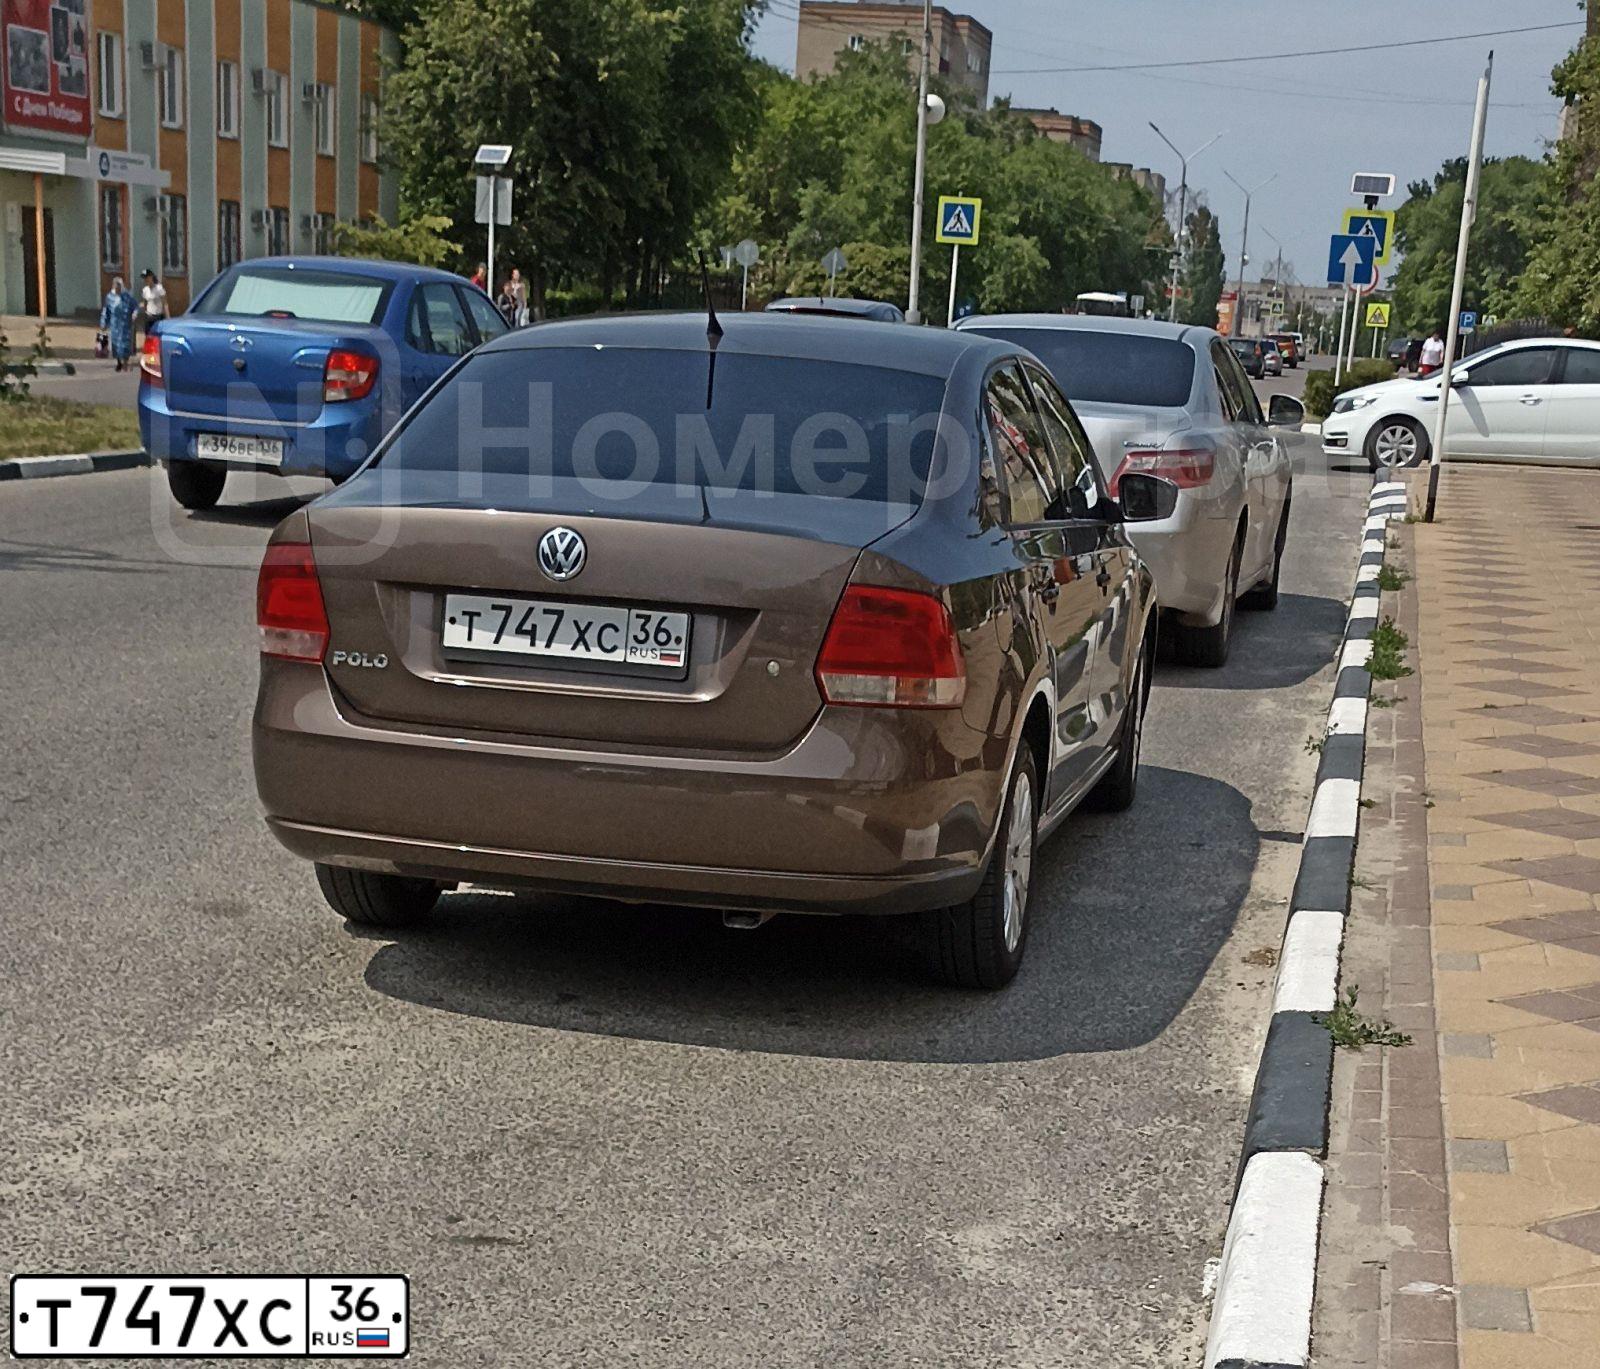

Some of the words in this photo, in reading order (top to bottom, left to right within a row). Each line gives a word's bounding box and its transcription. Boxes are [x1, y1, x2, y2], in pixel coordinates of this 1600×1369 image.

[632, 613, 673, 647] 36
[332, 650, 388, 668] POLO
[629, 646, 658, 660] RUS
